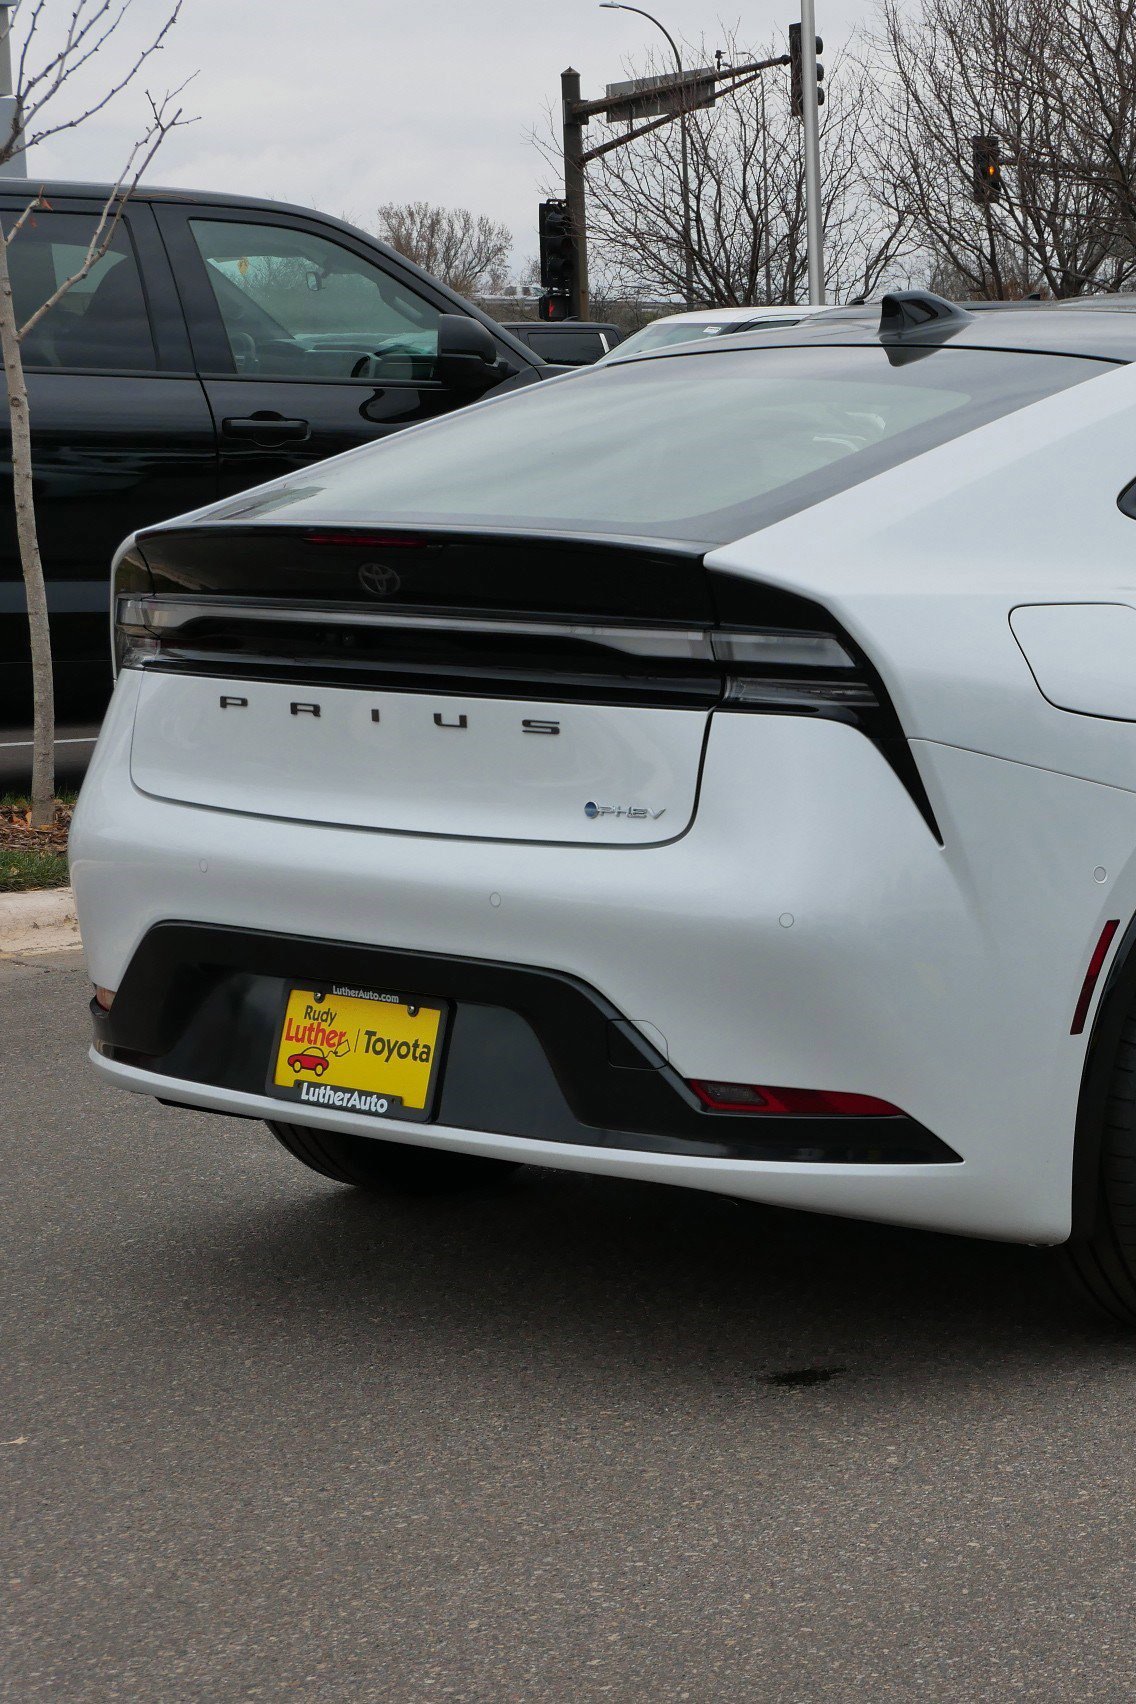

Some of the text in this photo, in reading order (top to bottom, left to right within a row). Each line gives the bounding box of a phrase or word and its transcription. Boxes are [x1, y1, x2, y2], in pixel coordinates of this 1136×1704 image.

[220, 695, 560, 735] PRIUS
[333, 985, 399, 1003] LutherAuto.com
[304, 1005, 337, 1027] Rudy
[285, 1018, 347, 1048] Luther
[364, 1029, 431, 1063] Toyota
[301, 1082, 388, 1113] LutherAuto
